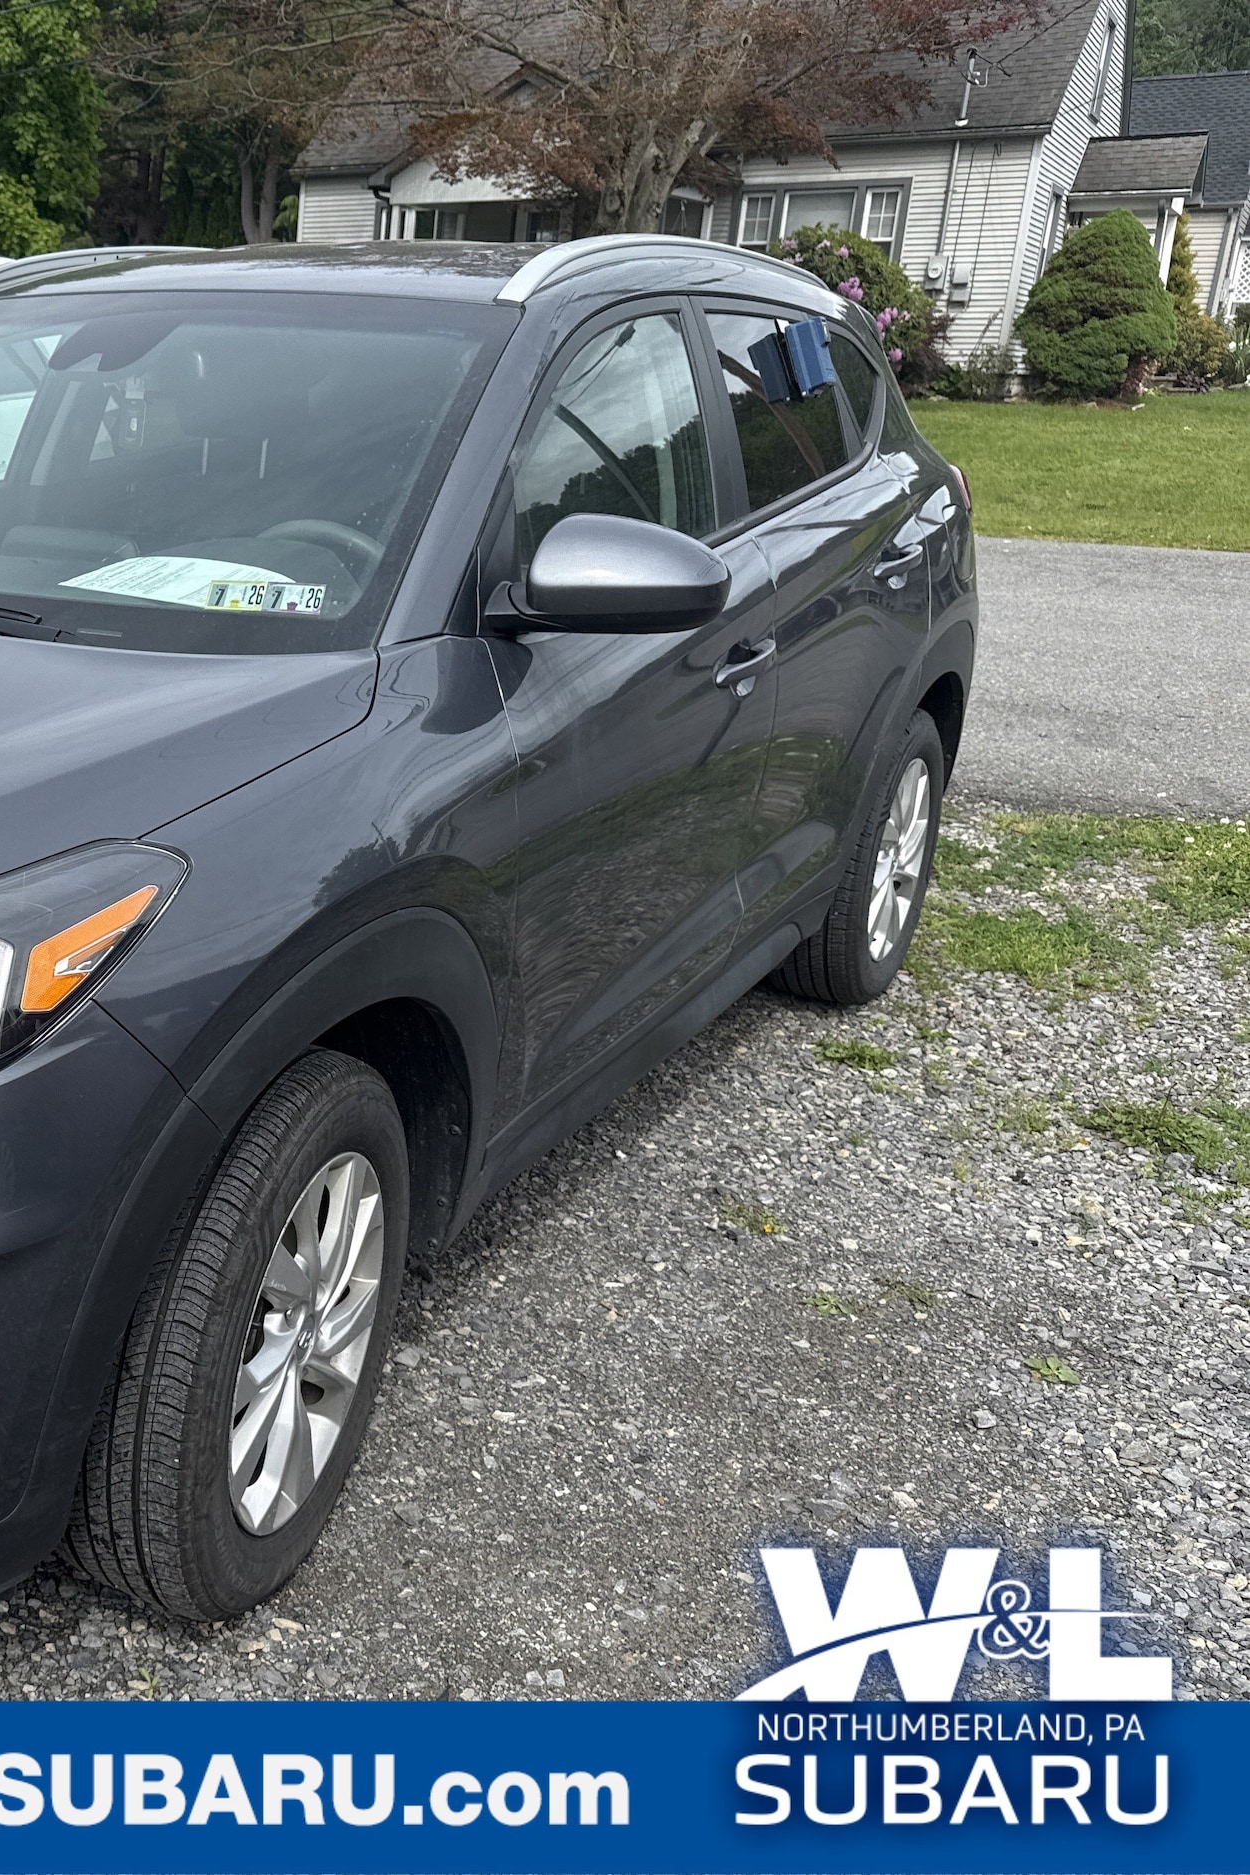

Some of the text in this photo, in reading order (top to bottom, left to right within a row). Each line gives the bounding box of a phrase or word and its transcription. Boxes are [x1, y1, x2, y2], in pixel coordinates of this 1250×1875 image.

[214, 588, 225, 606] 7
[248, 585, 265, 605] 26
[271, 590, 282, 608] 7
[305, 588, 323, 608] 26
